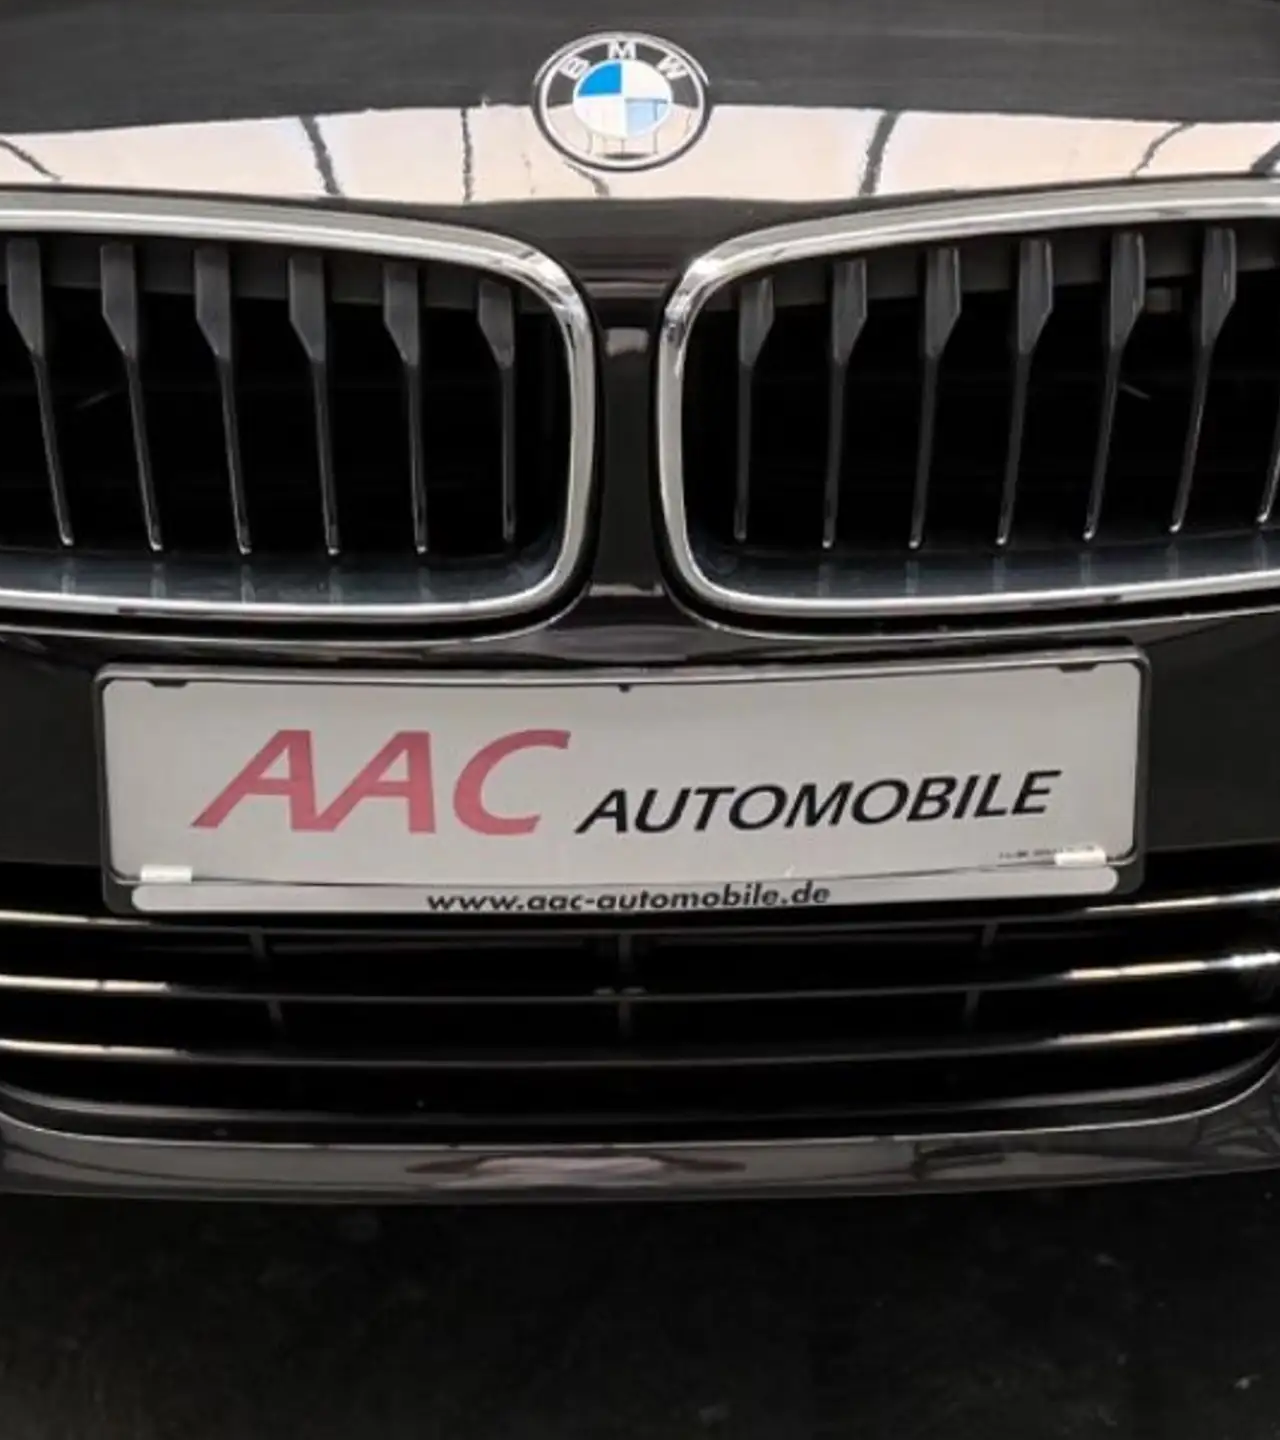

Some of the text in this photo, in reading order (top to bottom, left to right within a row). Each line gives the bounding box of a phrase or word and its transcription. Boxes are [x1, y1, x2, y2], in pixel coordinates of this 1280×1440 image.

[559, 40, 689, 80] BMW
[190, 729, 1062, 835] AAC AUTOMOBILE
[426, 881, 831, 912] www.aac-automobile.de
